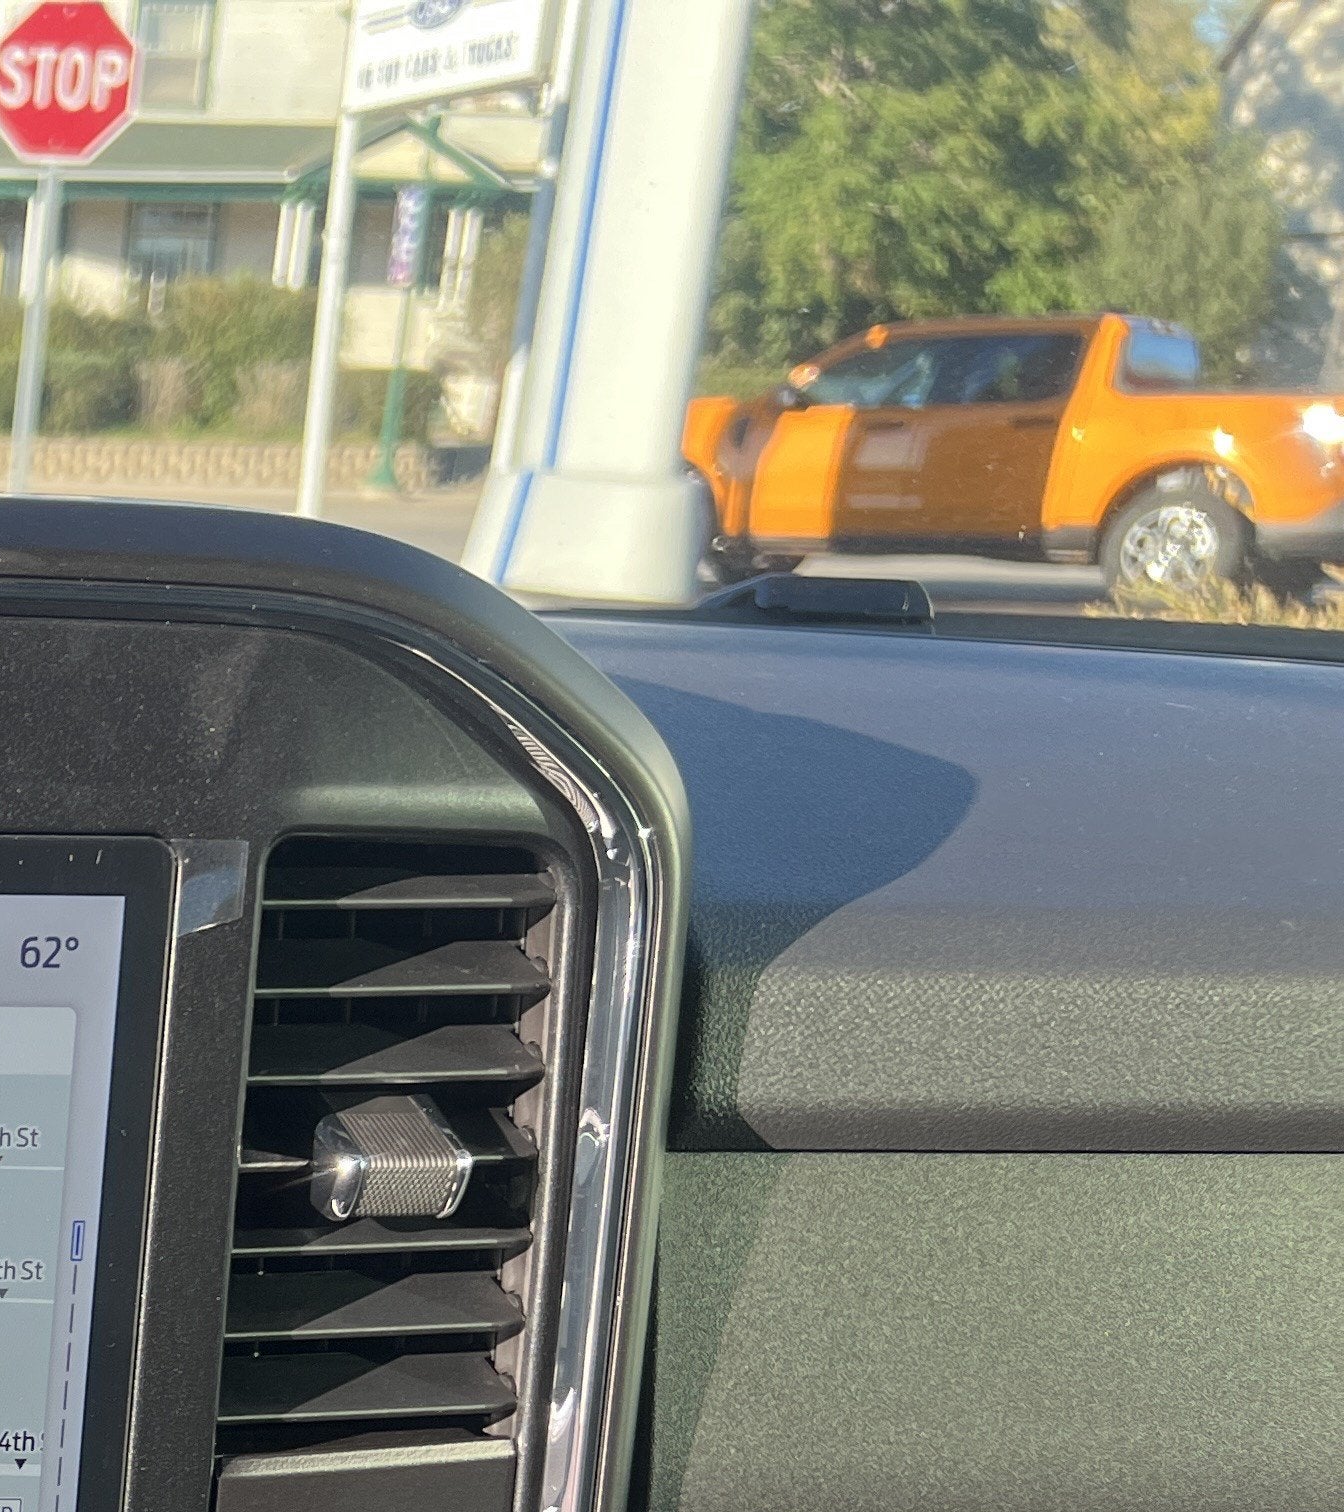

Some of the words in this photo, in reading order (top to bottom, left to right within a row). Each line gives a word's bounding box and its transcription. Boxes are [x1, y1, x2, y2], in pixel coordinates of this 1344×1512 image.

[20, 936, 80, 968] 62°
[16, 1128, 39, 1148] St
[19, 1261, 43, 1281] St
